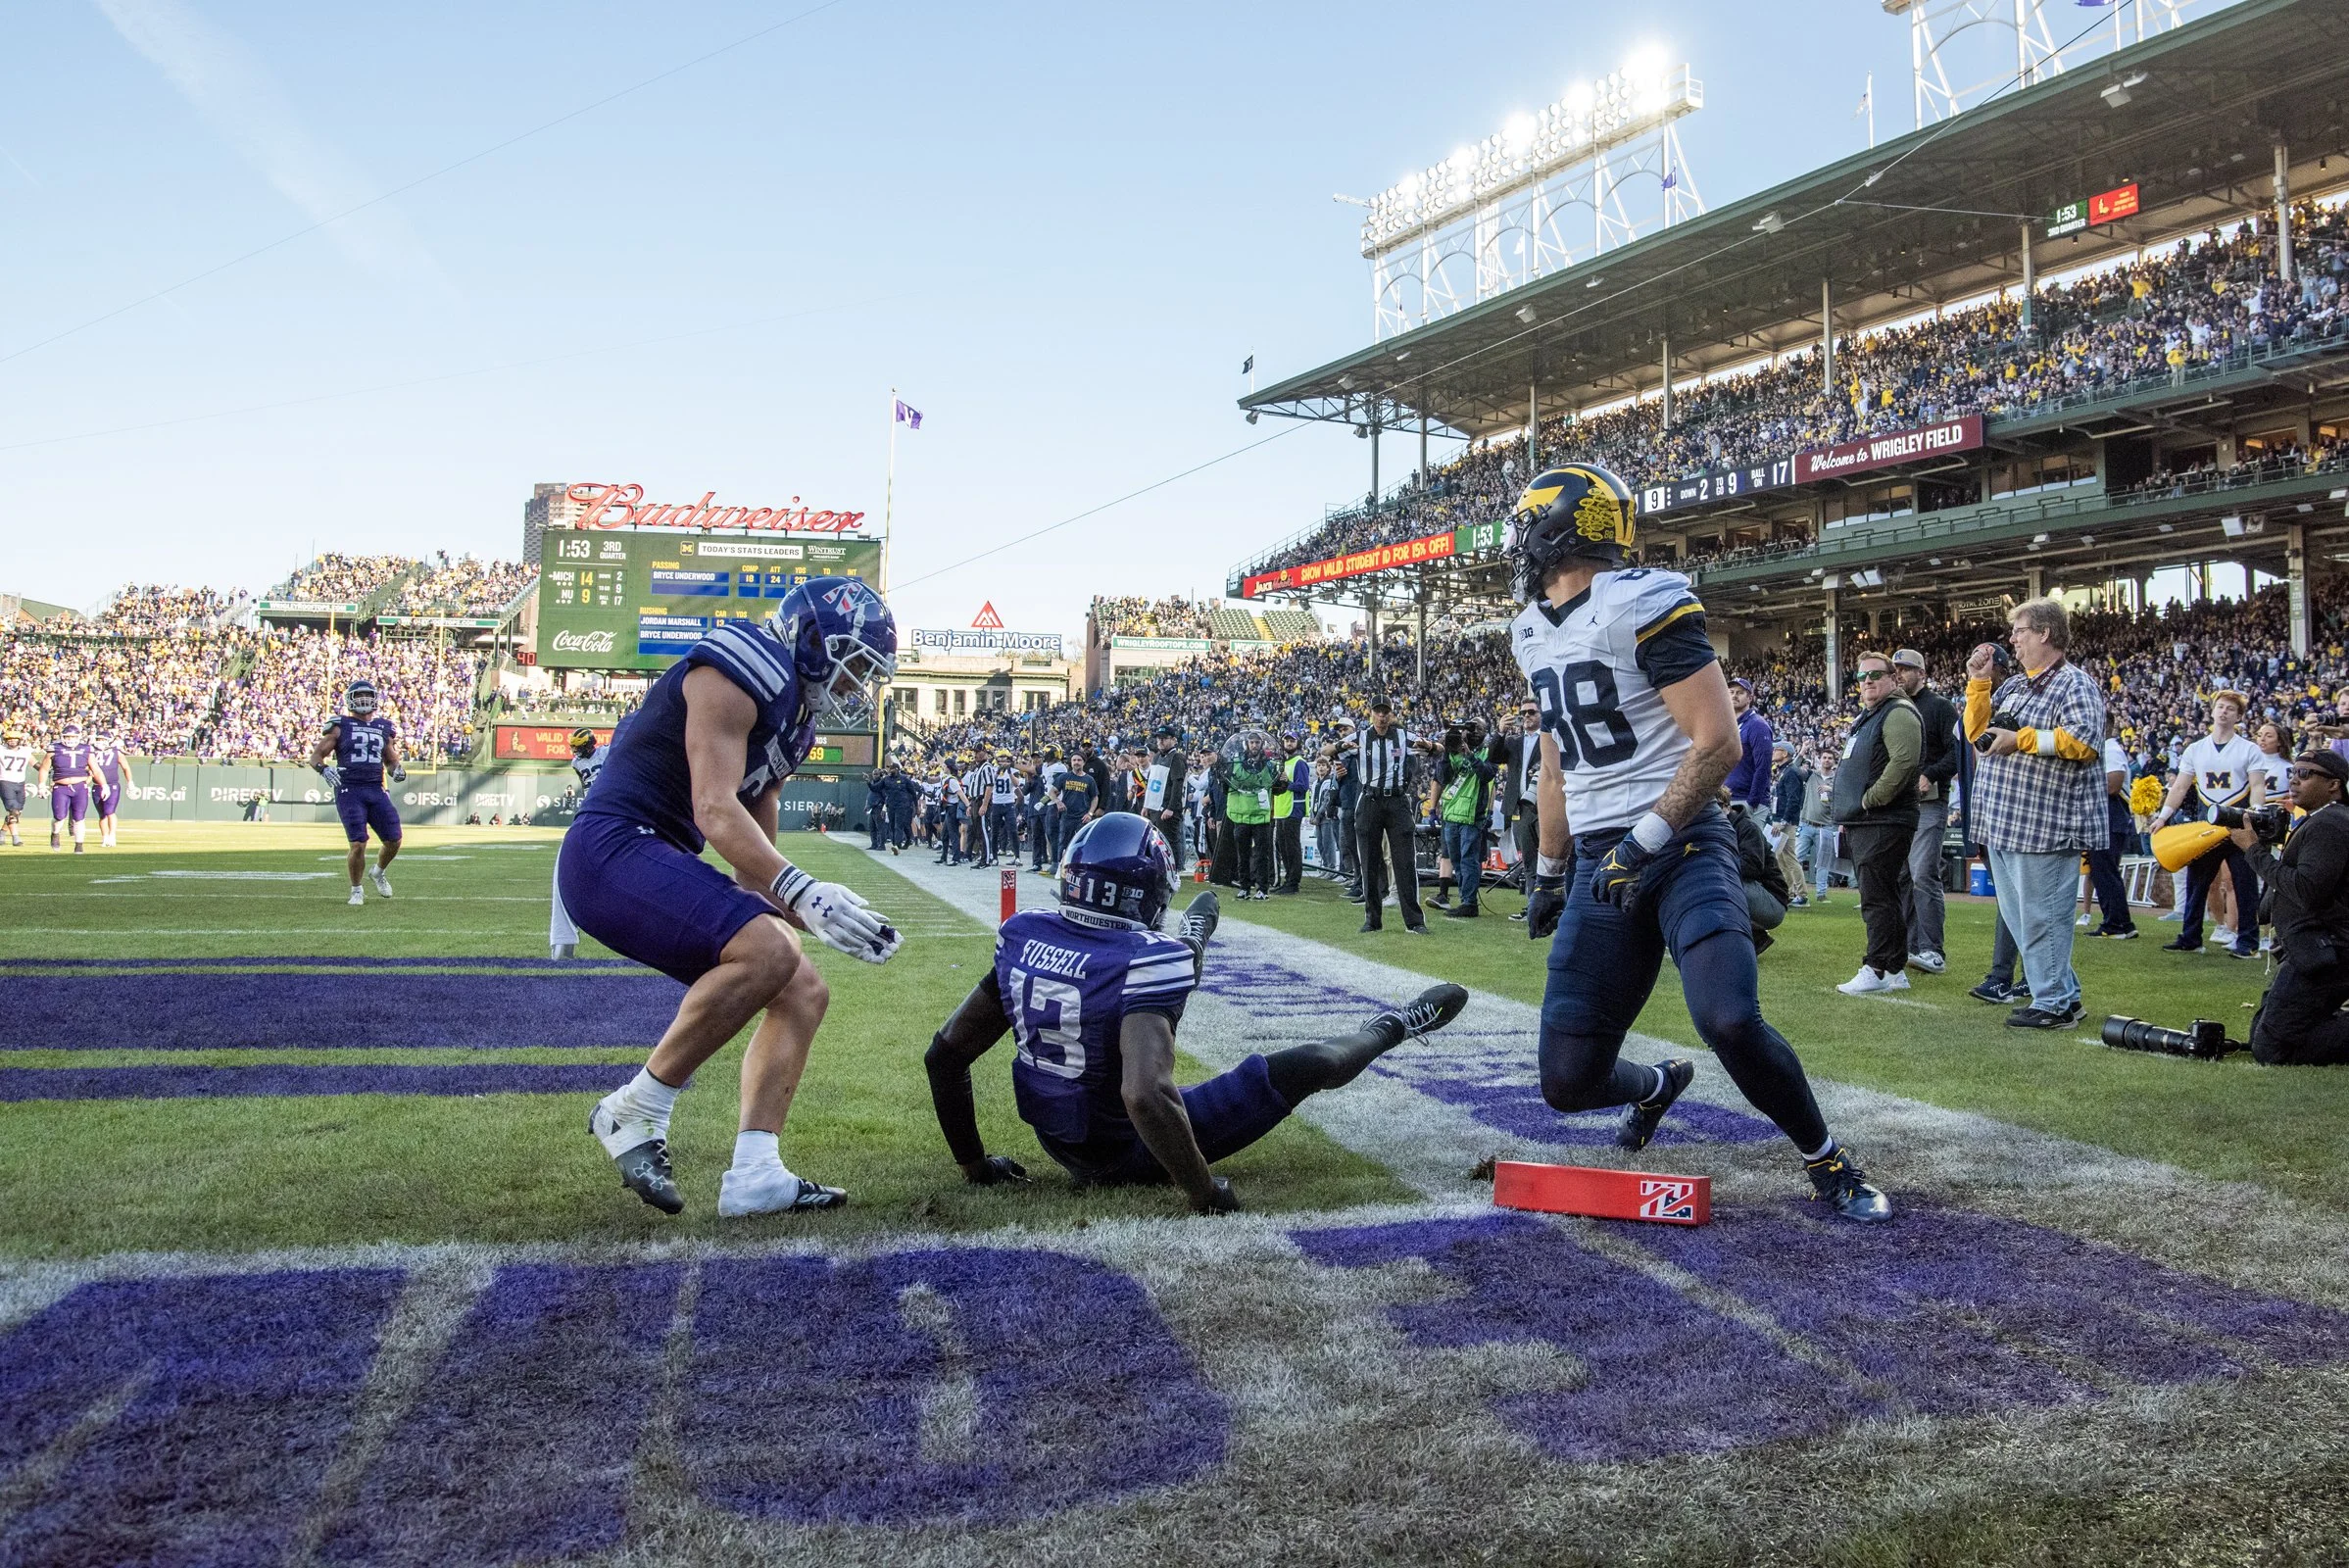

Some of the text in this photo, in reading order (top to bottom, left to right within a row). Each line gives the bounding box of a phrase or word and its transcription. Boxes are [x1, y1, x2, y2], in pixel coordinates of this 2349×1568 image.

[2056, 204, 2078, 223] 1:53
[2060, 218, 2086, 233] QUARTER
[1811, 425, 1963, 472] Welcome to WRIGLEY FIELD
[1751, 466, 1765, 479] BALL
[1772, 461, 1787, 485] 17
[1716, 477, 1724, 486] TO
[1728, 472, 1737, 495] 9
[1680, 478, 1709, 501] DOWN 2
[567, 482, 864, 532] Budweiser
[1651, 490, 1658, 510] 9
[1472, 525, 1493, 548] 1:53
[559, 539, 591, 559] 1:53
[604, 541, 621, 551] 3RD
[807, 545, 847, 555] WINTRUST
[1301, 535, 1449, 581] SHOW VALID STUDENT ID FOR 15% OFF!
[553, 571, 574, 581] MICH
[580, 571, 594, 586] 14
[617, 571, 623, 581] 2
[653, 571, 674, 580] BRYCE
[562, 590, 574, 600] NU
[581, 588, 591, 604] 9
[615, 584, 621, 594] 9
[613, 596, 623, 606] 17
[639, 607, 668, 615] RUSHING
[667, 617, 702, 626] MARSHALL
[662, 631, 703, 640] UNDERWOOD
[911, 629, 1061, 651] Benjamin Moore
[1117, 639, 1206, 651] WRIGLEYROOFTOPS.COM
[517, 653, 535, 665] 40
[1531, 660, 1639, 770] 88
[535, 733, 563, 743] VALID
[351, 731, 384, 763] 33
[547, 745, 565, 755] FOR
[809, 747, 823, 760] 59
[4, 755, 26, 772] 77
[98, 752, 115, 766] 47
[996, 778, 1011, 794] 81
[2206, 771, 2231, 789] M
[142, 787, 186, 802] IFS.ai
[417, 792, 459, 807] IFS.ai
[475, 793, 515, 808] DIRECTV
[1086, 878, 1117, 906] 13
[1065, 909, 1133, 931] NORTHWESTERN
[1019, 939, 1092, 980] FUSSELL
[1008, 966, 1086, 1080] 13
